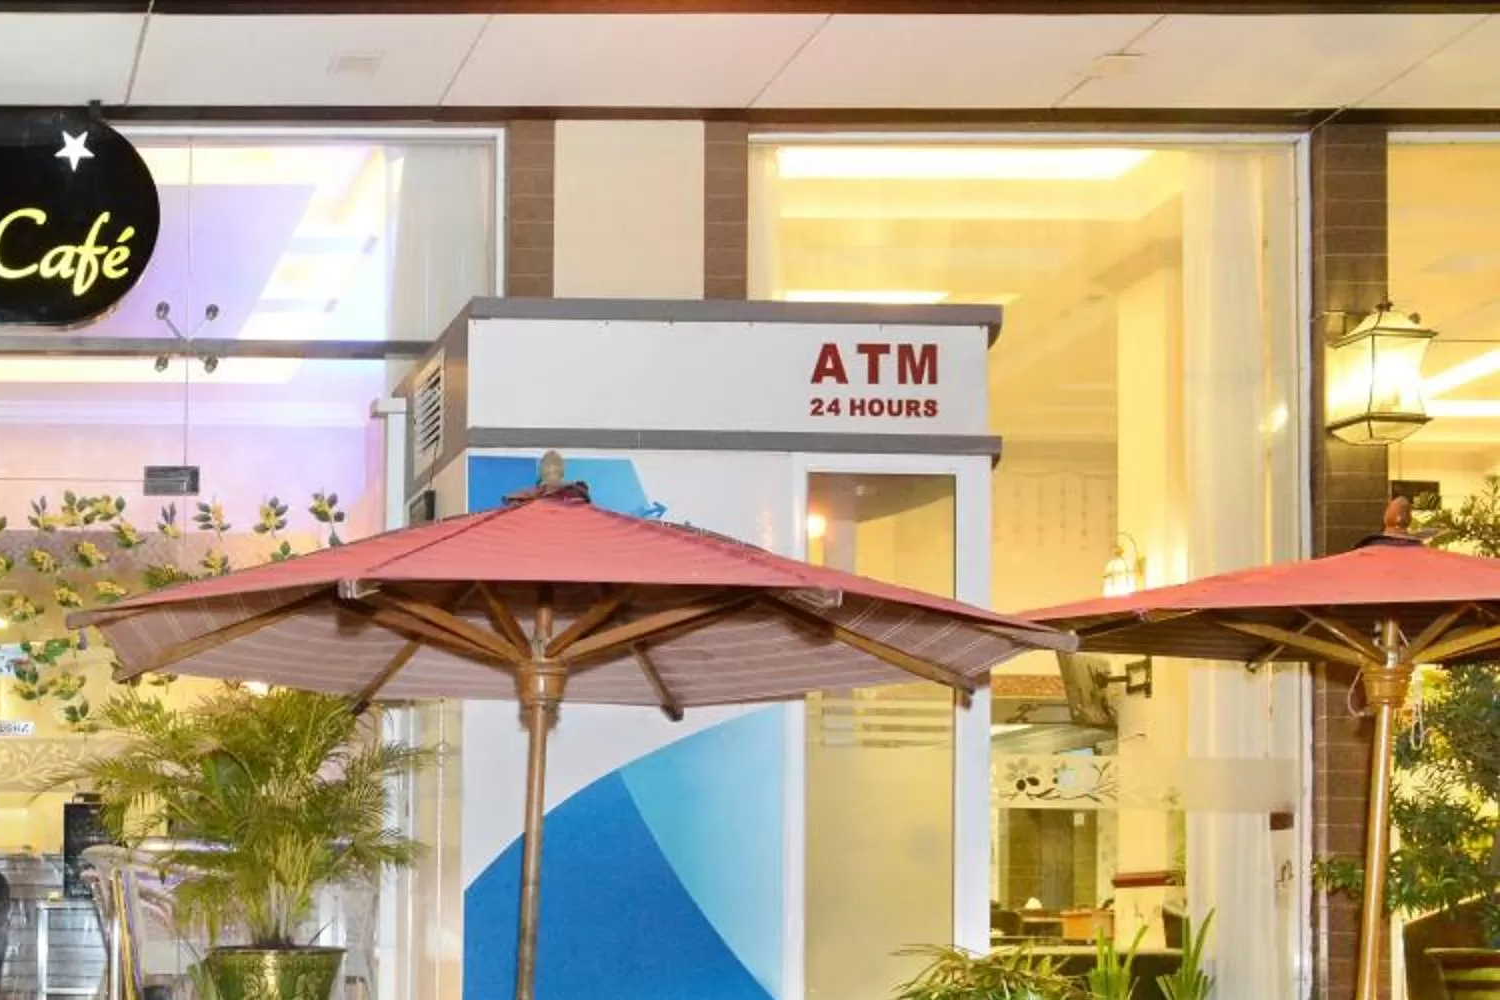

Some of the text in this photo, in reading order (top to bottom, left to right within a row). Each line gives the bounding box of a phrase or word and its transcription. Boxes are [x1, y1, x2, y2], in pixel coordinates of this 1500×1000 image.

[810, 343, 938, 385] ATM
[810, 397, 938, 418] 24 HOURS
